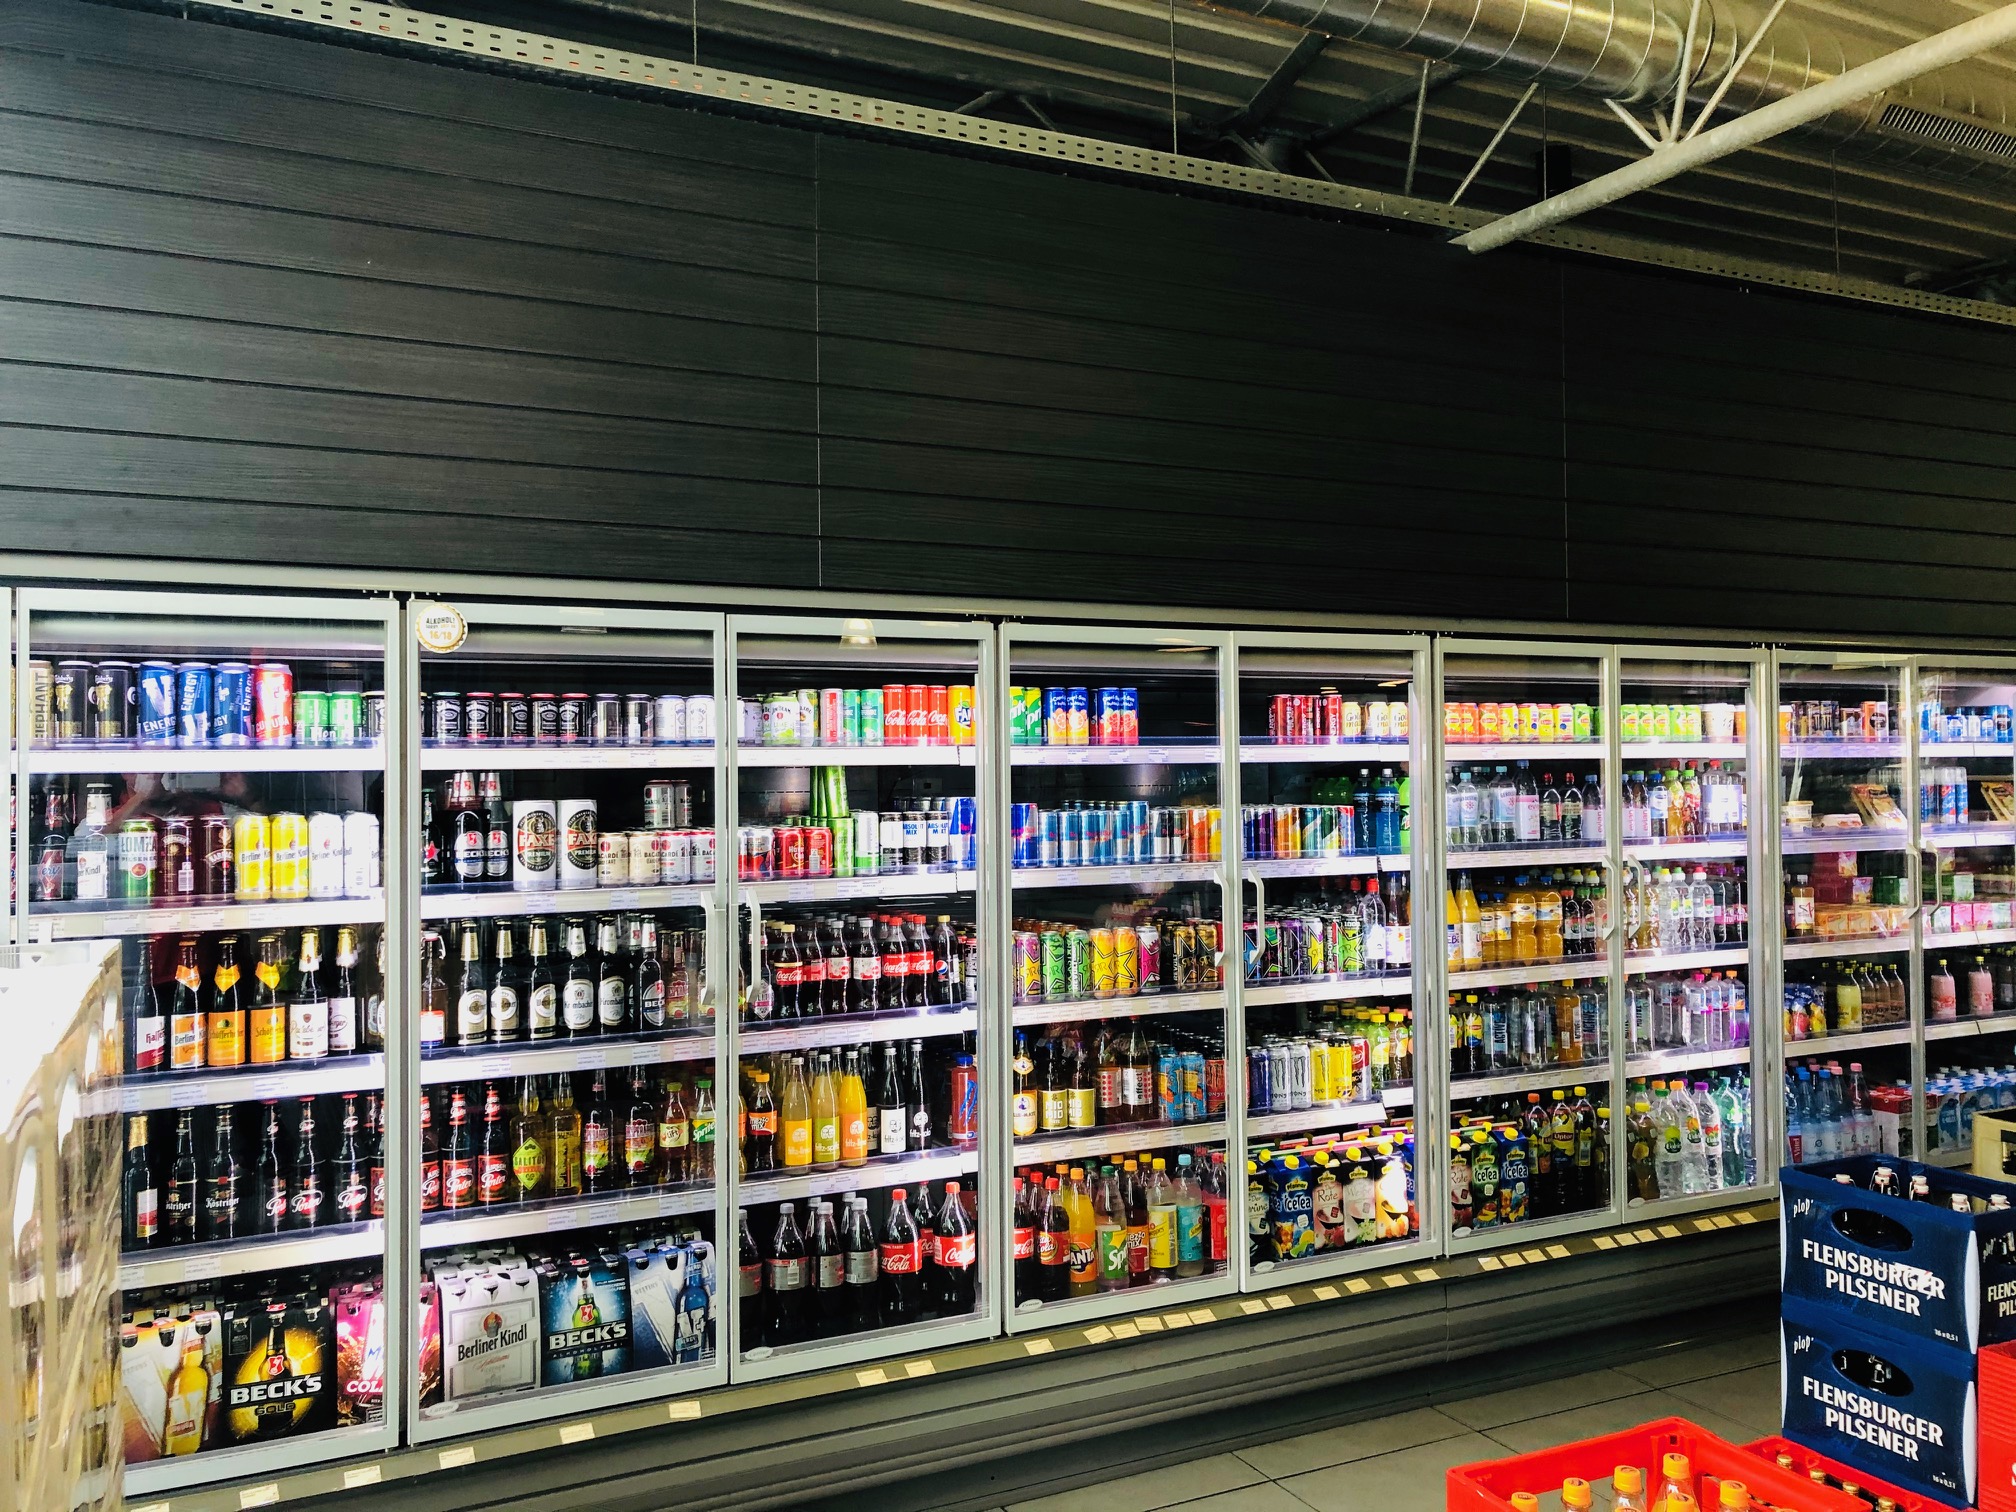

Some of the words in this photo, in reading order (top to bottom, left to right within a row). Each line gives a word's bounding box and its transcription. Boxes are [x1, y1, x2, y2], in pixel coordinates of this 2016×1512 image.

[519, 834, 556, 847] FAXE
[481, 1172, 507, 1188] Porter
[1317, 1189, 1339, 1203] Rote
[1802, 1239, 1946, 1300] FLENSBURGER
[1825, 1268, 1921, 1317] PILSENER
[457, 1336, 499, 1361] Berliner
[500, 1324, 528, 1347] Kindl
[550, 1322, 627, 1350] BECK'S
[230, 1374, 323, 1406] BECK'S
[254, 1401, 296, 1416] GOLD
[1803, 1375, 1944, 1447] FLENSBURGER
[1825, 1406, 1920, 1462] PILSENER
